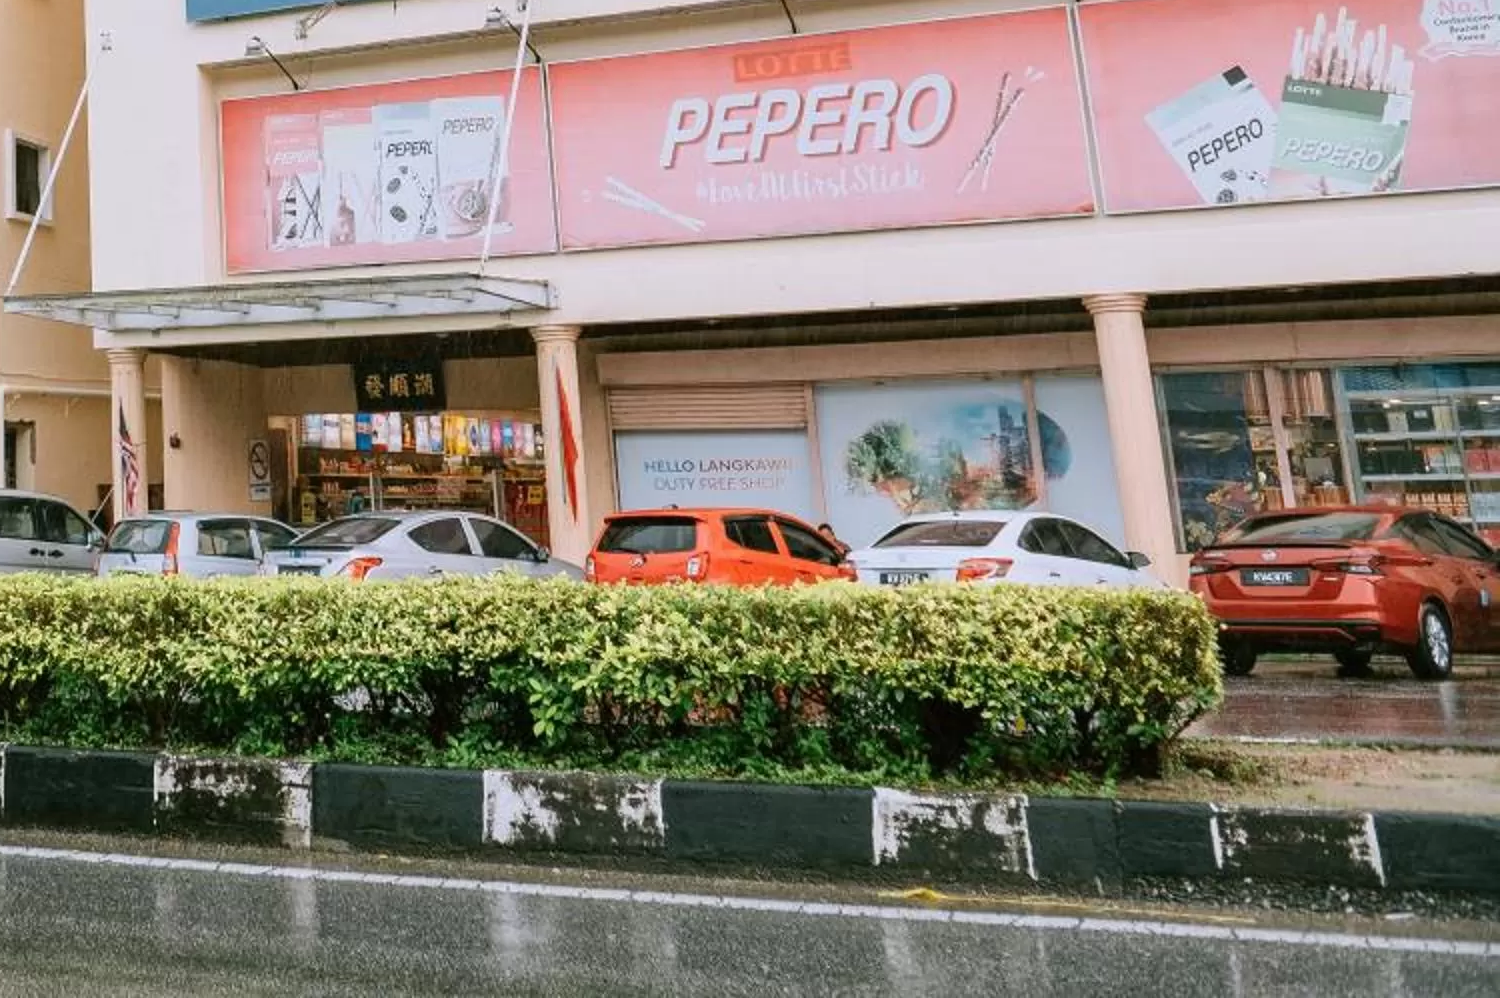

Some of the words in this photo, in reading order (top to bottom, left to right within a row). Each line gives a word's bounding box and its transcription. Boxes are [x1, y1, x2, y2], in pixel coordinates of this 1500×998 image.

[736, 47, 852, 80] LOTTE
[441, 116, 495, 136] PEPERO
[660, 73, 956, 169] PEPERO
[1187, 118, 1263, 172] PEPERO
[1282, 137, 1385, 171] PEPERO
[644, 459, 695, 473] HELLO
[653, 477, 695, 491] DUTY
[699, 477, 736, 490] FREE
[738, 476, 786, 490] SHOP
